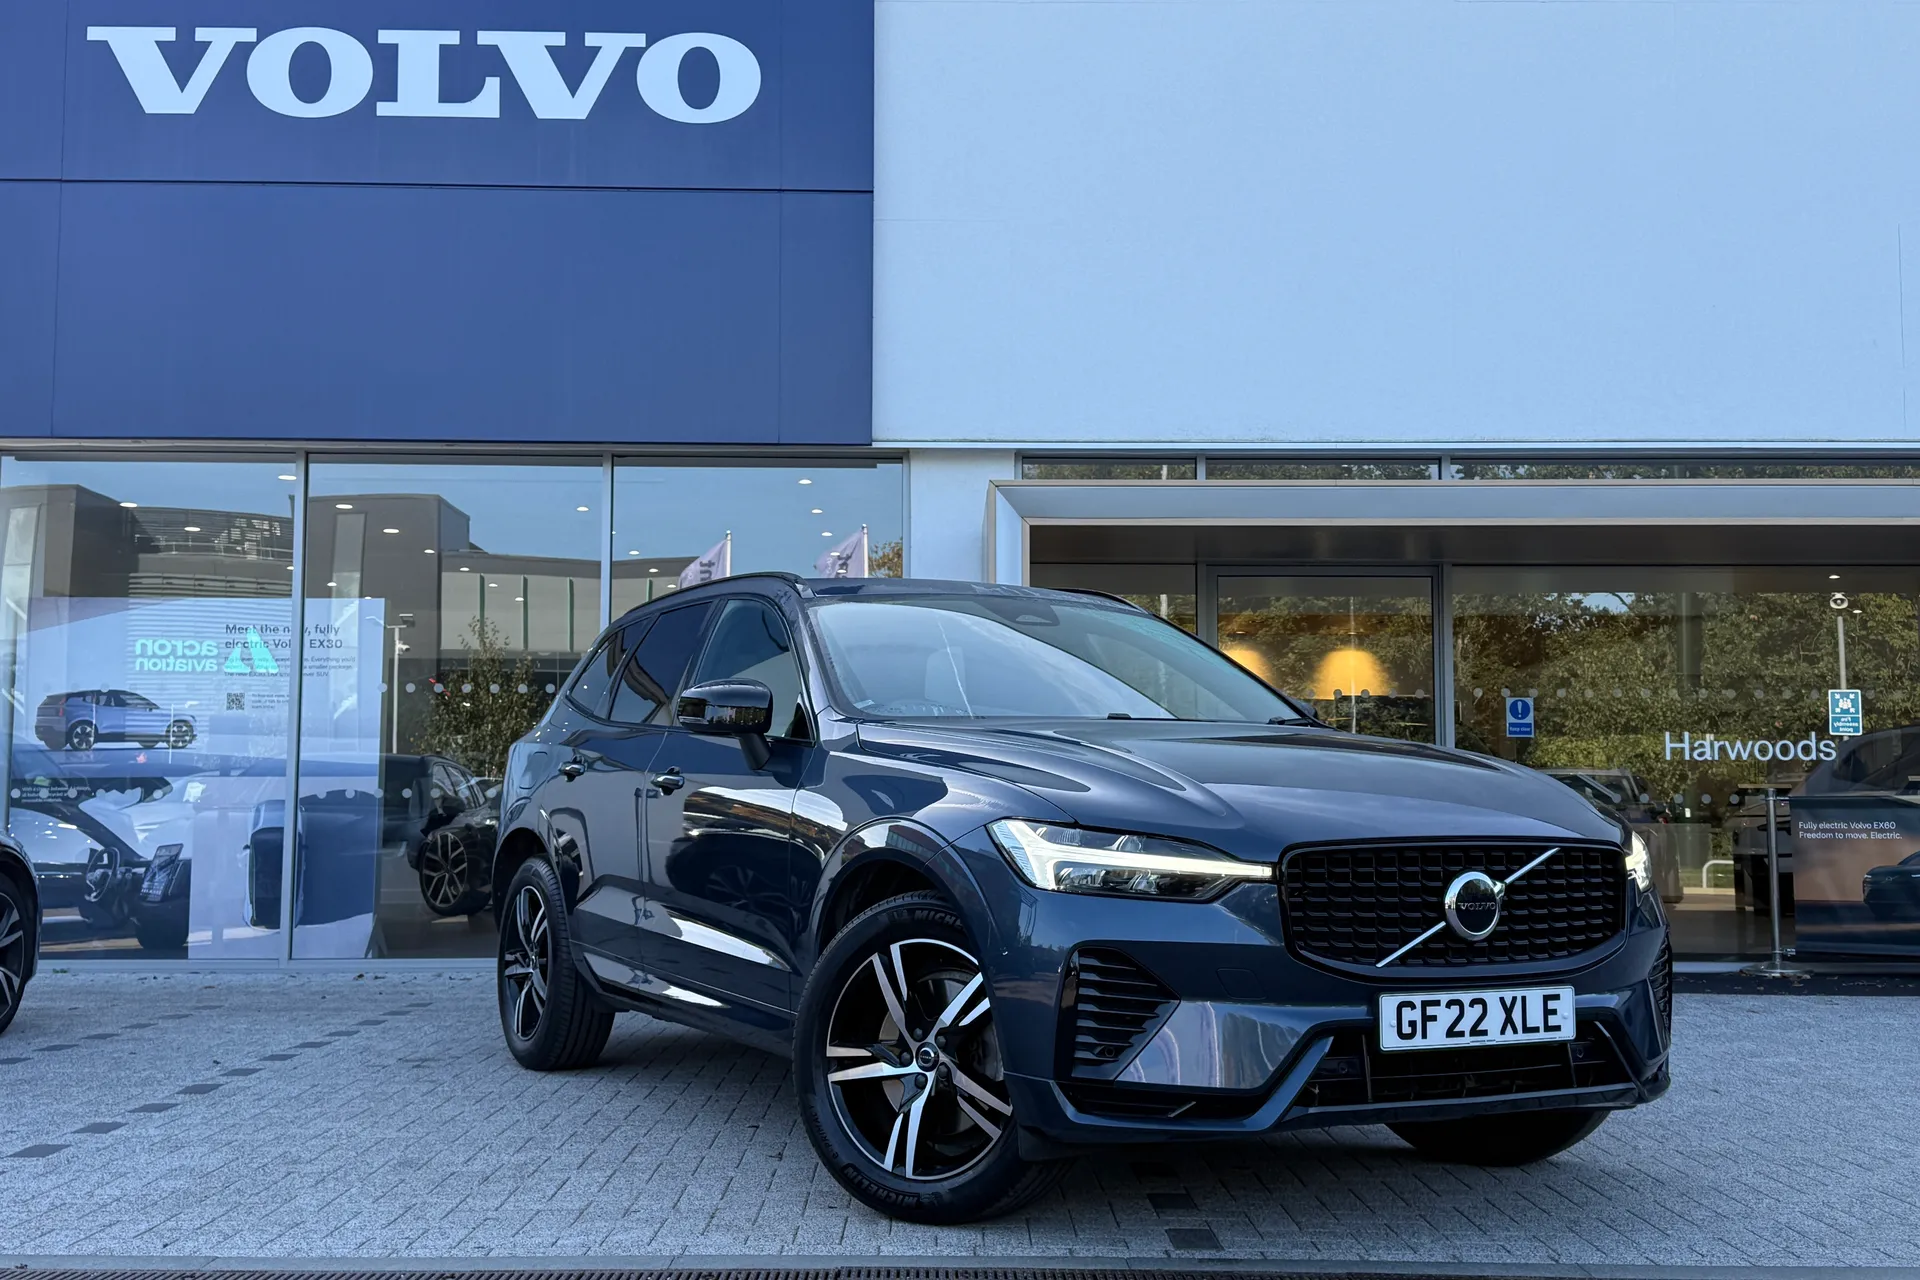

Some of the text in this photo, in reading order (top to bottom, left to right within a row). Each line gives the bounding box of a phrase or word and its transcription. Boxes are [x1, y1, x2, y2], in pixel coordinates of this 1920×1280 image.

[86, 26, 762, 124] VOLVO
[225, 624, 257, 635] Meet
[260, 624, 281, 634] the
[315, 624, 340, 638] fully
[225, 639, 269, 649] electric
[309, 639, 343, 649] EX30
[1665, 731, 1837, 761] Harwoods
[1798, 821, 1897, 831] Fully electric Volvo EX60
[1799, 831, 1903, 840] Freedom to move. Electric.
[1457, 901, 1497, 911] VOLVO
[1396, 993, 1562, 1041] GF22 XLE
[843, 1165, 919, 1208] MICHELIN
